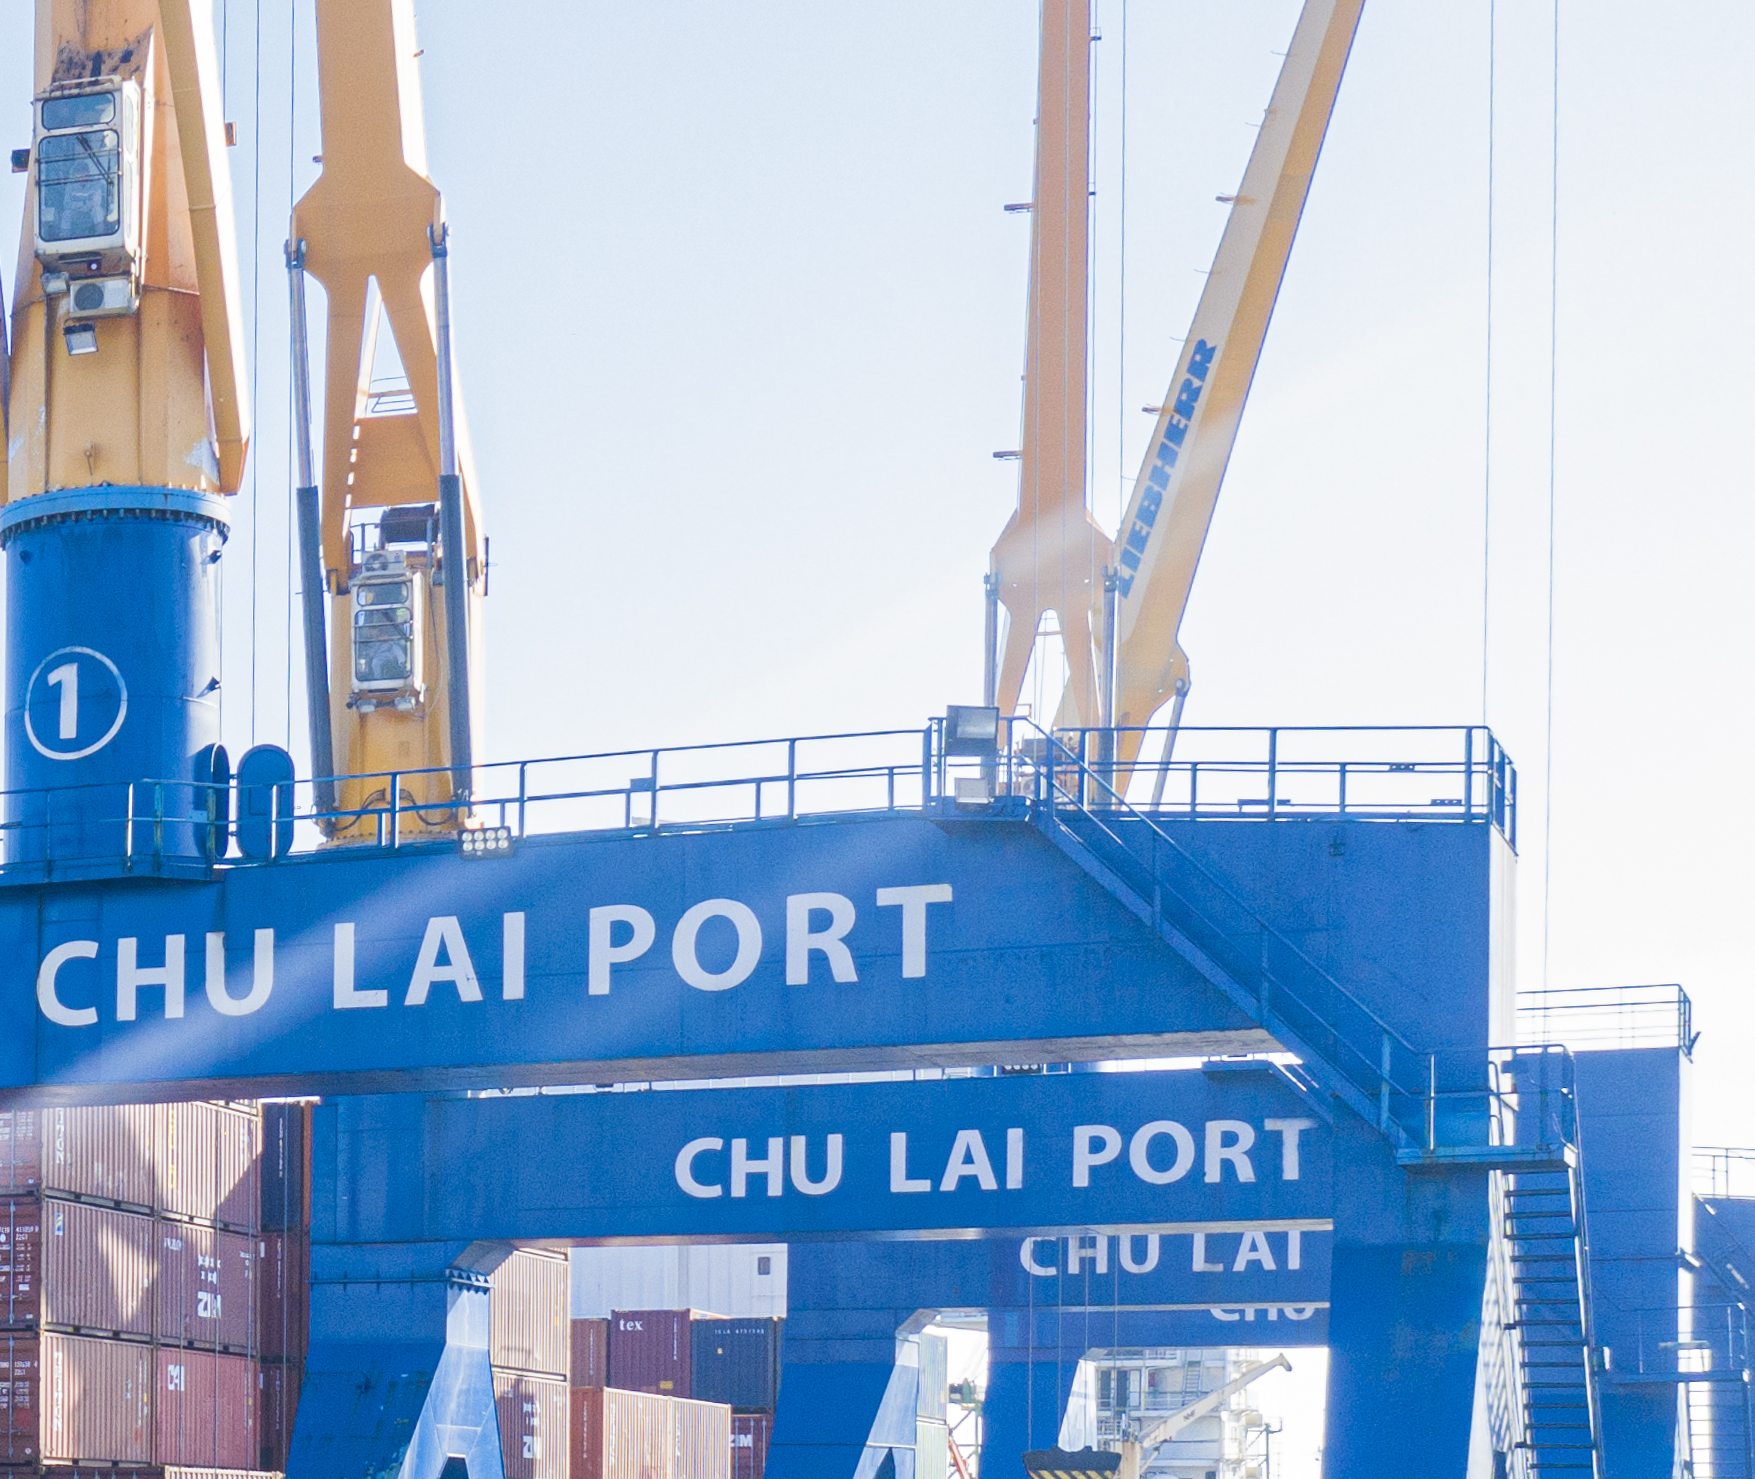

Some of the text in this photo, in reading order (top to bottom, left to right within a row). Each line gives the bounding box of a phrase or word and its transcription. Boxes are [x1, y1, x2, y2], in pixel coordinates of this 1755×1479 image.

[1117, 338, 1218, 599] LIEBHERR
[47, 662, 78, 740] 1
[36, 884, 952, 1027] CHU LAI PORT
[675, 1119, 1311, 1198] CHU LAI PORT
[1020, 1231, 1301, 1276] CHU LAI
[619, 1319, 643, 1331] tex
